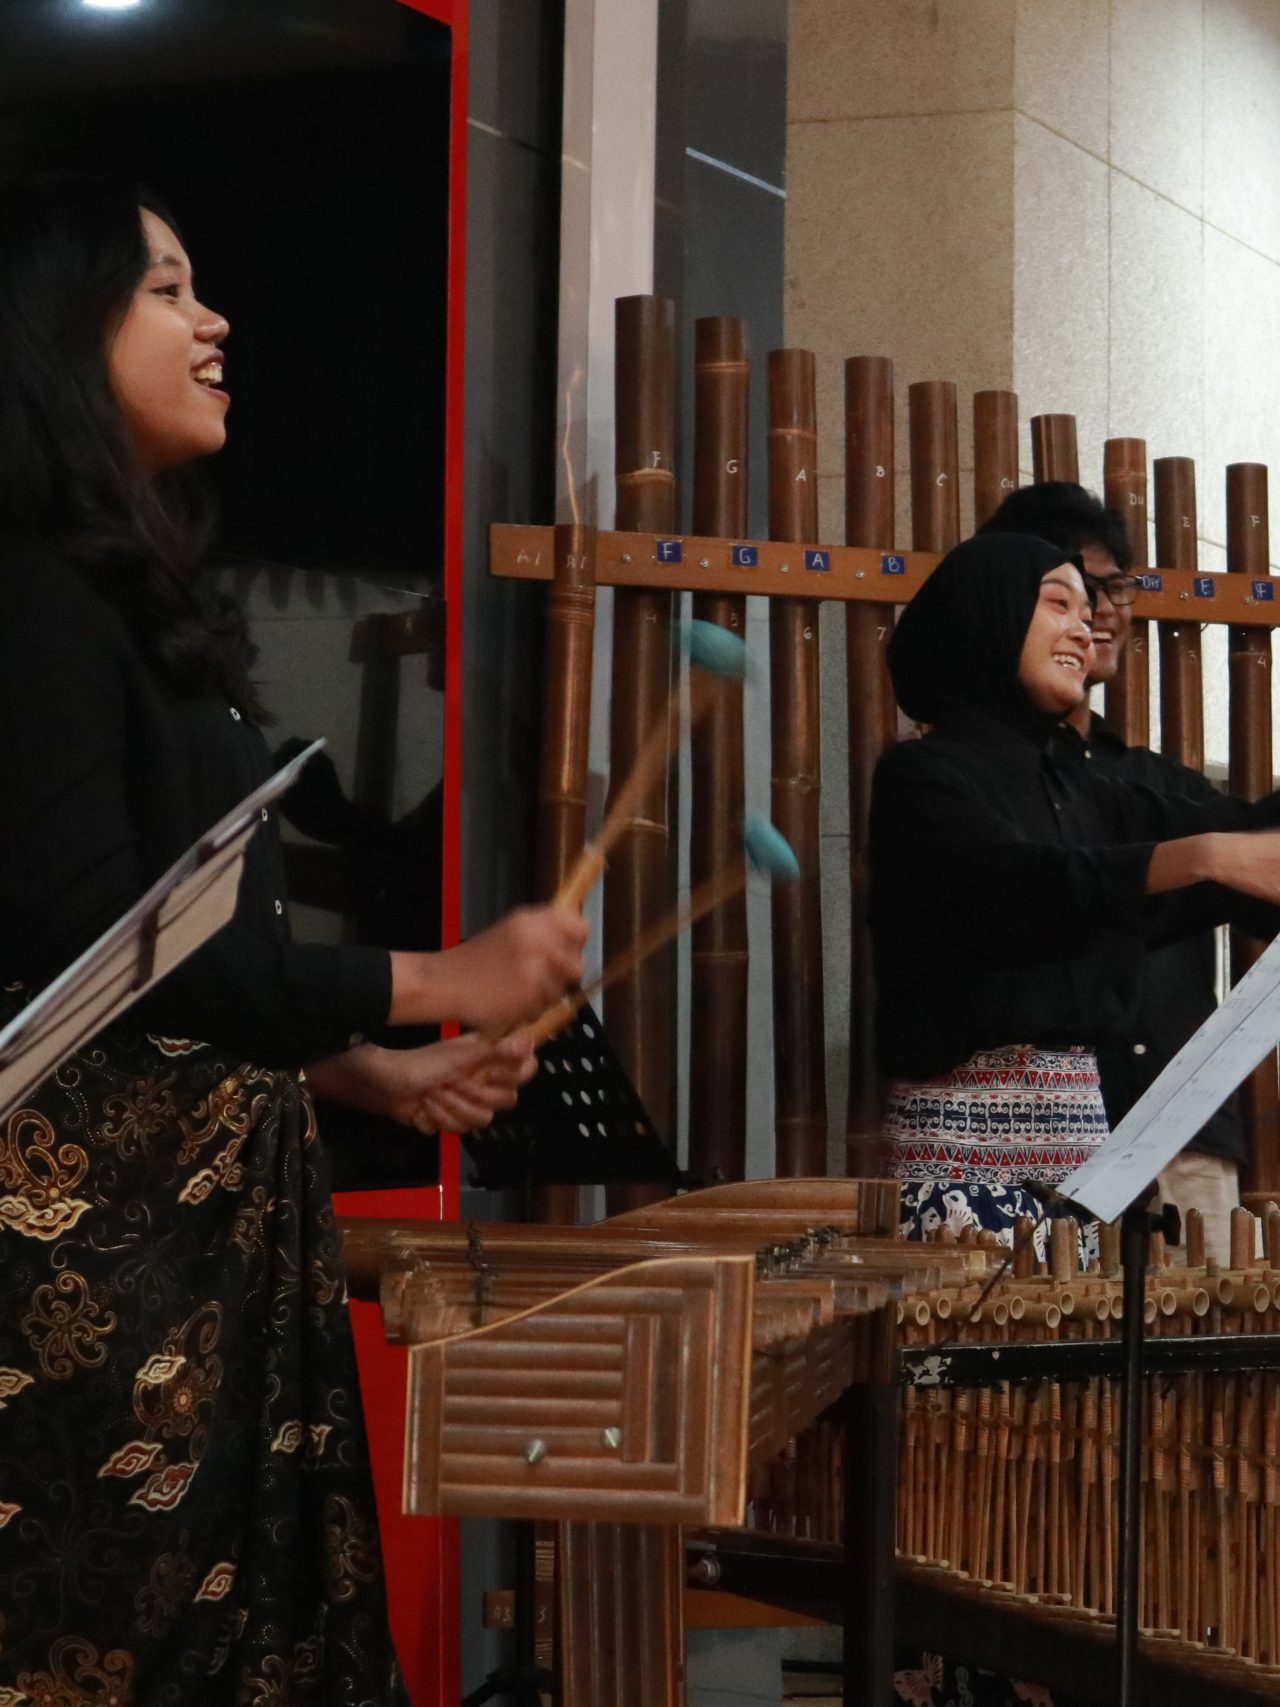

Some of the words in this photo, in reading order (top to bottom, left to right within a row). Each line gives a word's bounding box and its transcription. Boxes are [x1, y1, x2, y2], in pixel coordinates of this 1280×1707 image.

[652, 451, 661, 468] F
[726, 460, 738, 474] G
[795, 468, 807, 481] A
[936, 473, 948, 486] C
[1182, 516, 1190, 528] E
[1250, 515, 1260, 528] F
[662, 543, 673, 560] F
[738, 548, 751, 564] G
[812, 554, 824, 568] A
[888, 557, 900, 572] B
[1200, 578, 1211, 595] E
[1257, 583, 1266, 598] F
[803, 626, 812, 640] 6
[877, 626, 887, 641] 7
